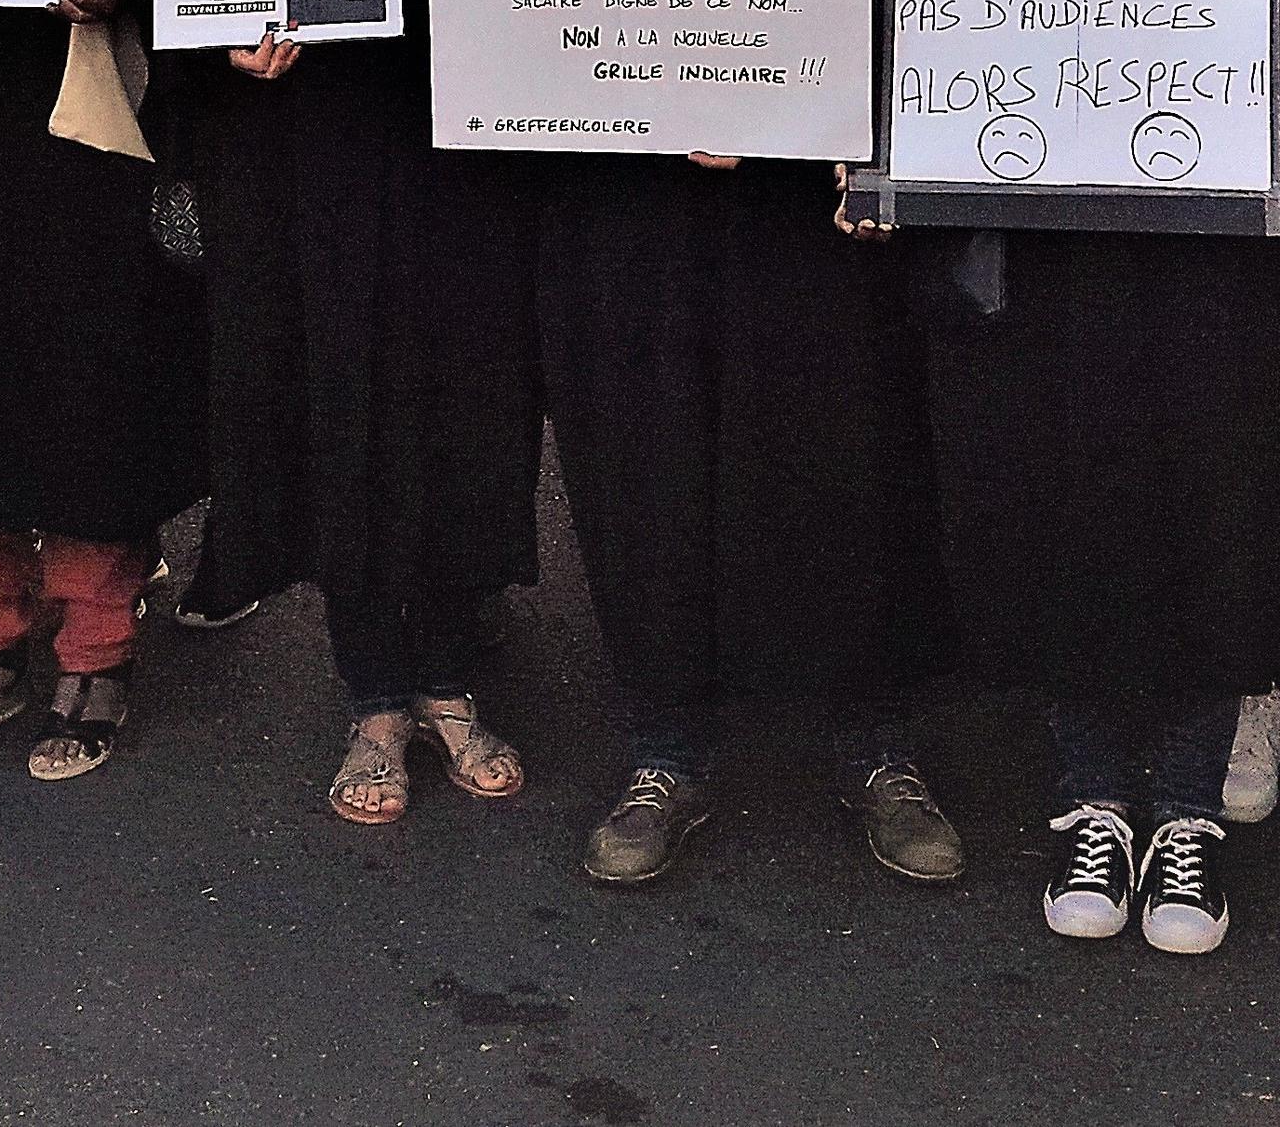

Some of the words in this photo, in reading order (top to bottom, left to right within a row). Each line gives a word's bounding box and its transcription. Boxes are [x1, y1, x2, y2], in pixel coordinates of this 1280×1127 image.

[180, 5, 226, 14] DEVENEZ
[228, 2, 274, 12] GREFFIER
[563, 27, 599, 49] NON
[617, 30, 628, 48] A
[638, 30, 658, 46] LA
[673, 31, 768, 48] NOUVELLE
[594, 62, 663, 81] GRILLE
[680, 66, 786, 84] INDICIAIRE
[800, 58, 826, 86] !!!
[900, 64, 1037, 114] ALORS
